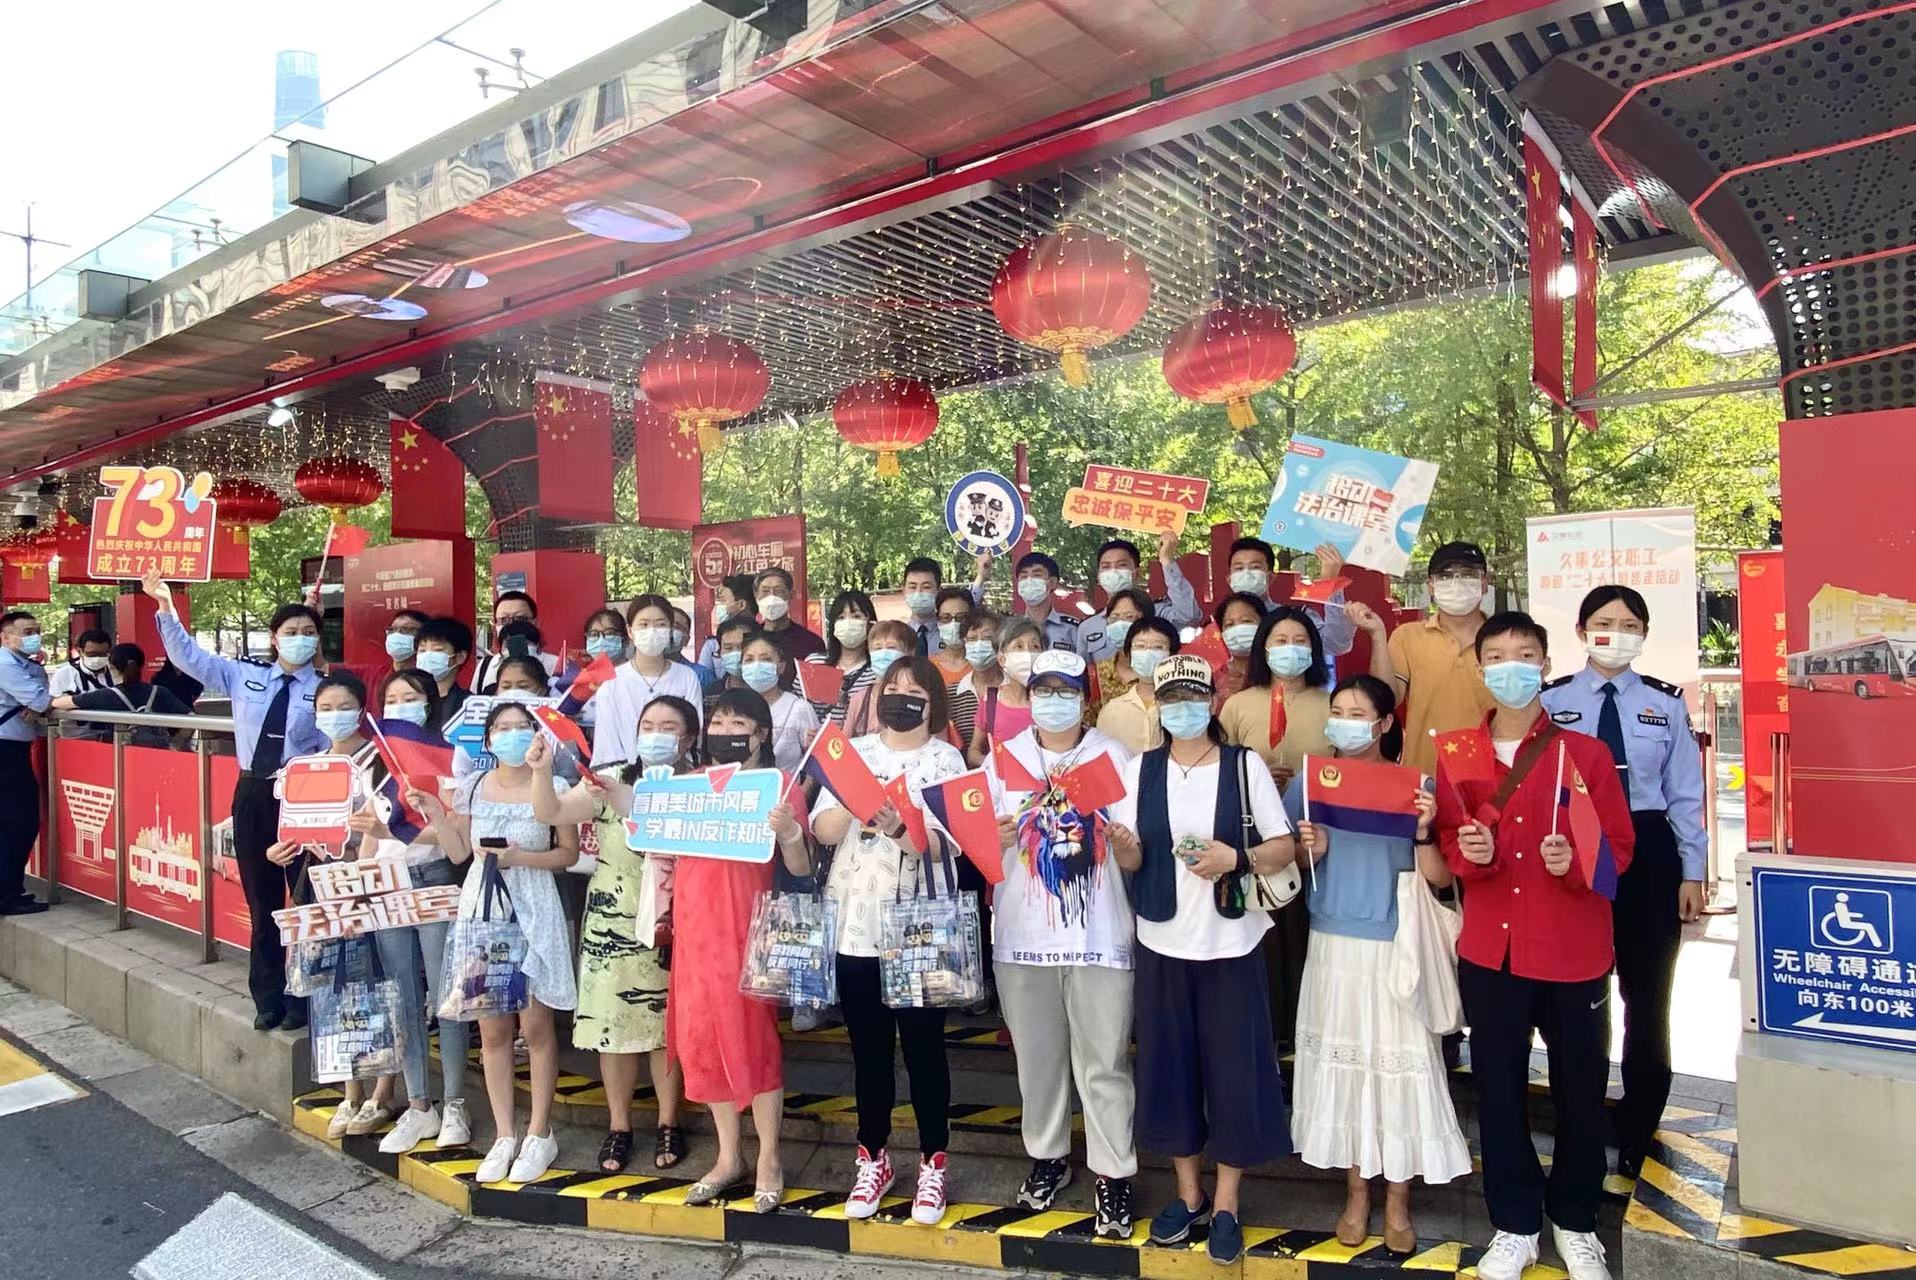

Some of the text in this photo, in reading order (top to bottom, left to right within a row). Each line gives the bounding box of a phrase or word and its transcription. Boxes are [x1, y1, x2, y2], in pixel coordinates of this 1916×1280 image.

[1094, 471, 1198, 504] 喜迎二十大
[101, 468, 177, 539] 73
[1069, 494, 1177, 530] 忠诚保平安
[96, 539, 202, 553] 热烈庆祝中华人民共和国
[96, 553, 197, 576] 成立73周年
[1157, 668, 1205, 682] NOTHING
[311, 857, 411, 901] 移动
[1046, 952, 1060, 963] TO
[1773, 972, 1852, 991] Wheelchair
[1798, 988, 1914, 1018] 向东100米
